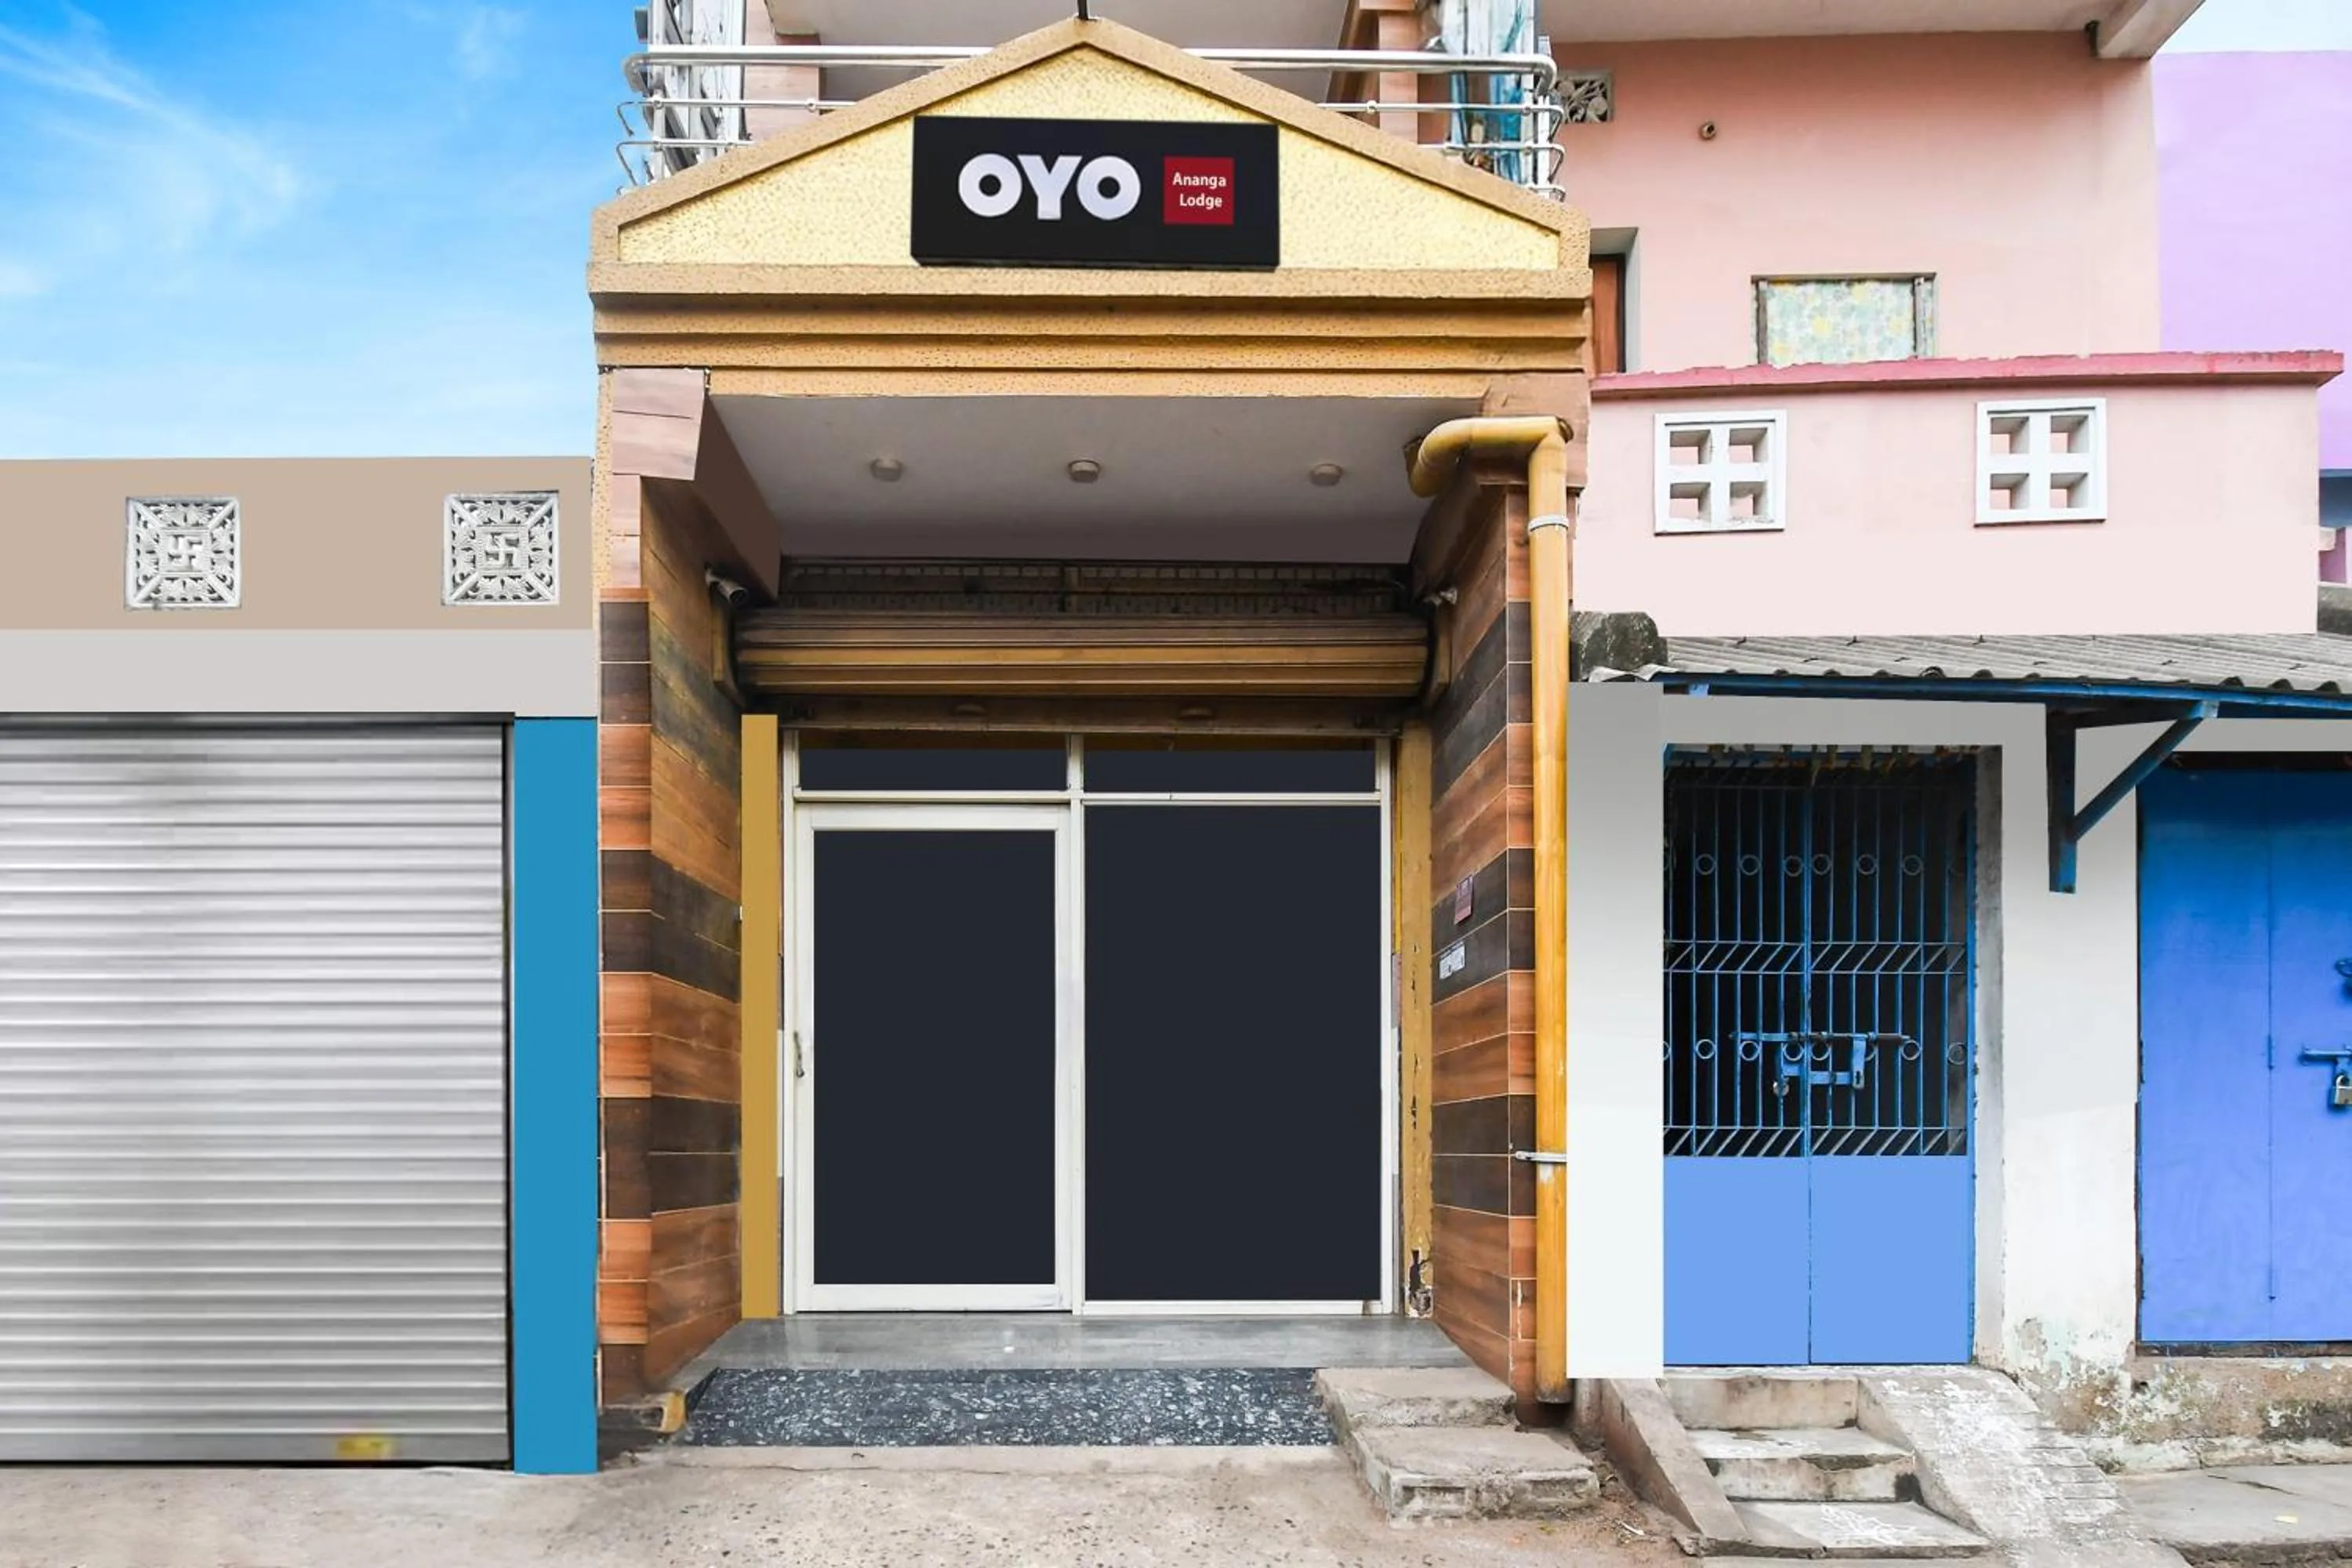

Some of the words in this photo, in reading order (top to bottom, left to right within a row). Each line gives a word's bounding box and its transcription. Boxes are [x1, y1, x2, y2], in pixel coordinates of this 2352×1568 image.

[958, 153, 1142, 220] OYO
[1172, 172, 1226, 190] Ananga
[1179, 193, 1222, 210] Lodge
